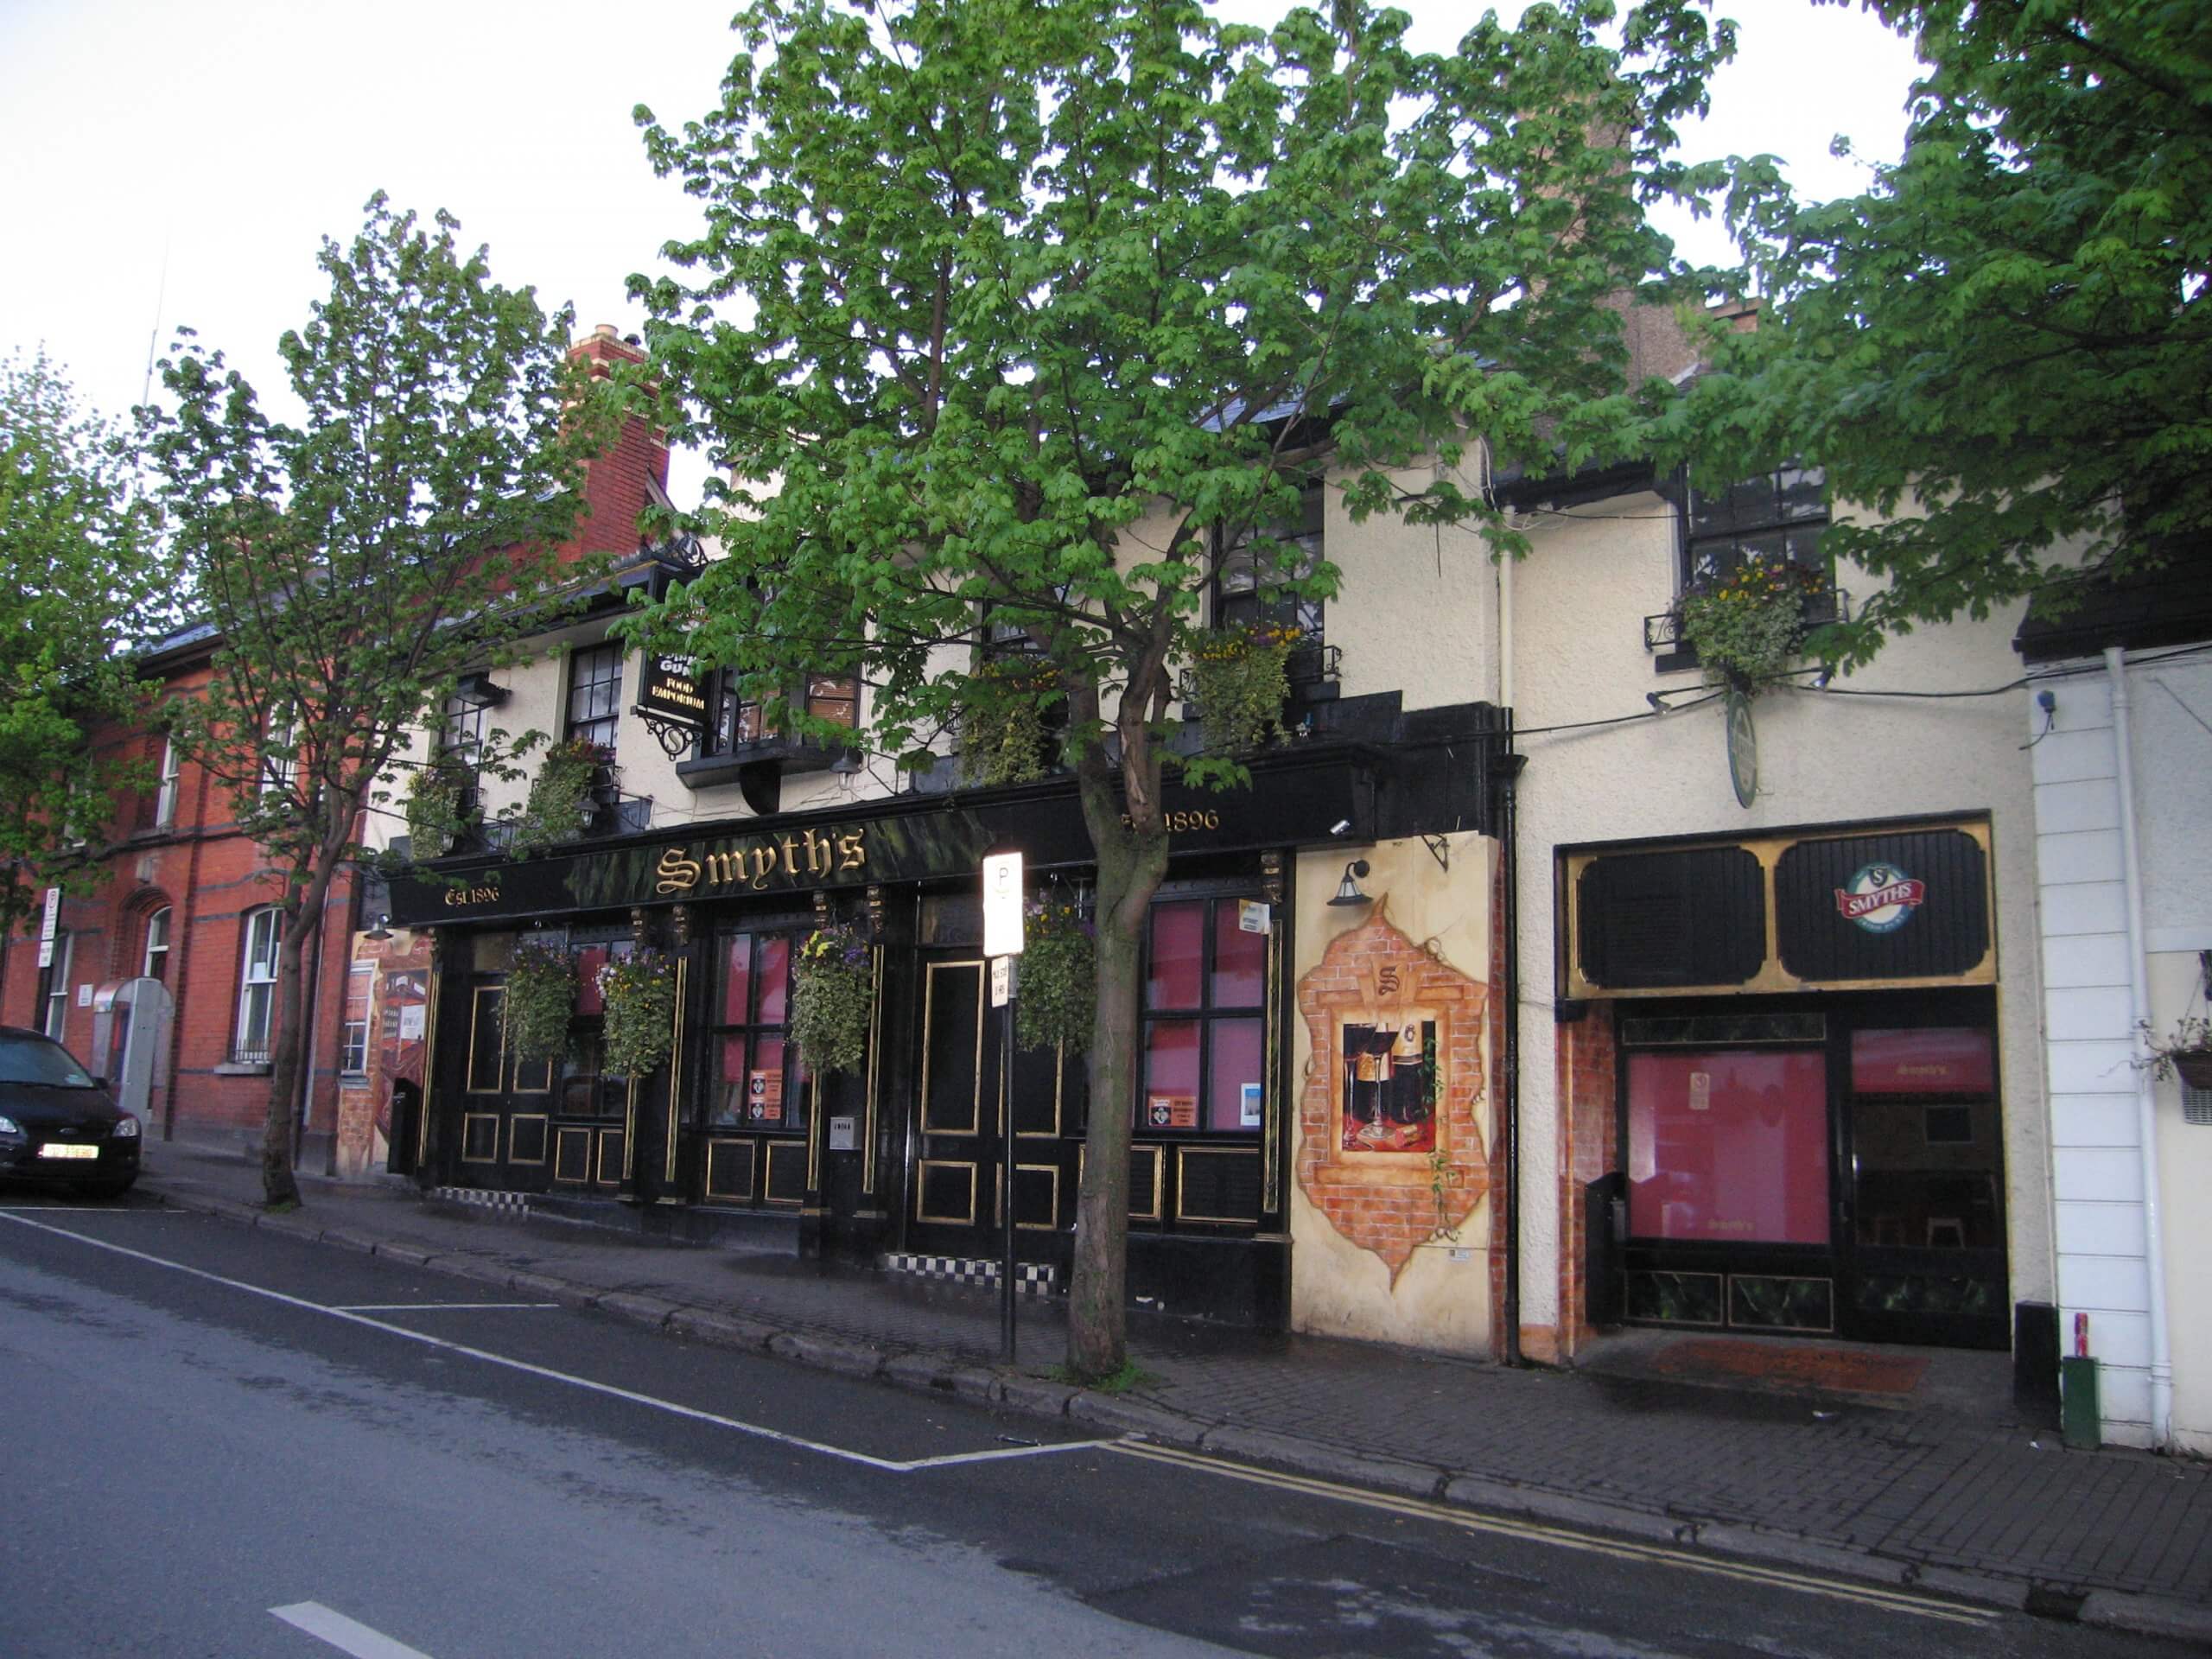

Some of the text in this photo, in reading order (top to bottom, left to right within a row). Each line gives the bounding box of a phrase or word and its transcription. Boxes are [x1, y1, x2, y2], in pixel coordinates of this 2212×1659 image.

[666, 677, 693, 693] FOOD
[652, 685, 704, 709] EMPORIUM
[1164, 810, 1218, 831] 1896
[657, 829, 865, 894] Smyth's
[1873, 868, 1885, 885] S
[472, 887, 499, 903] 1896
[1849, 883, 1912, 914] SMYTHS
